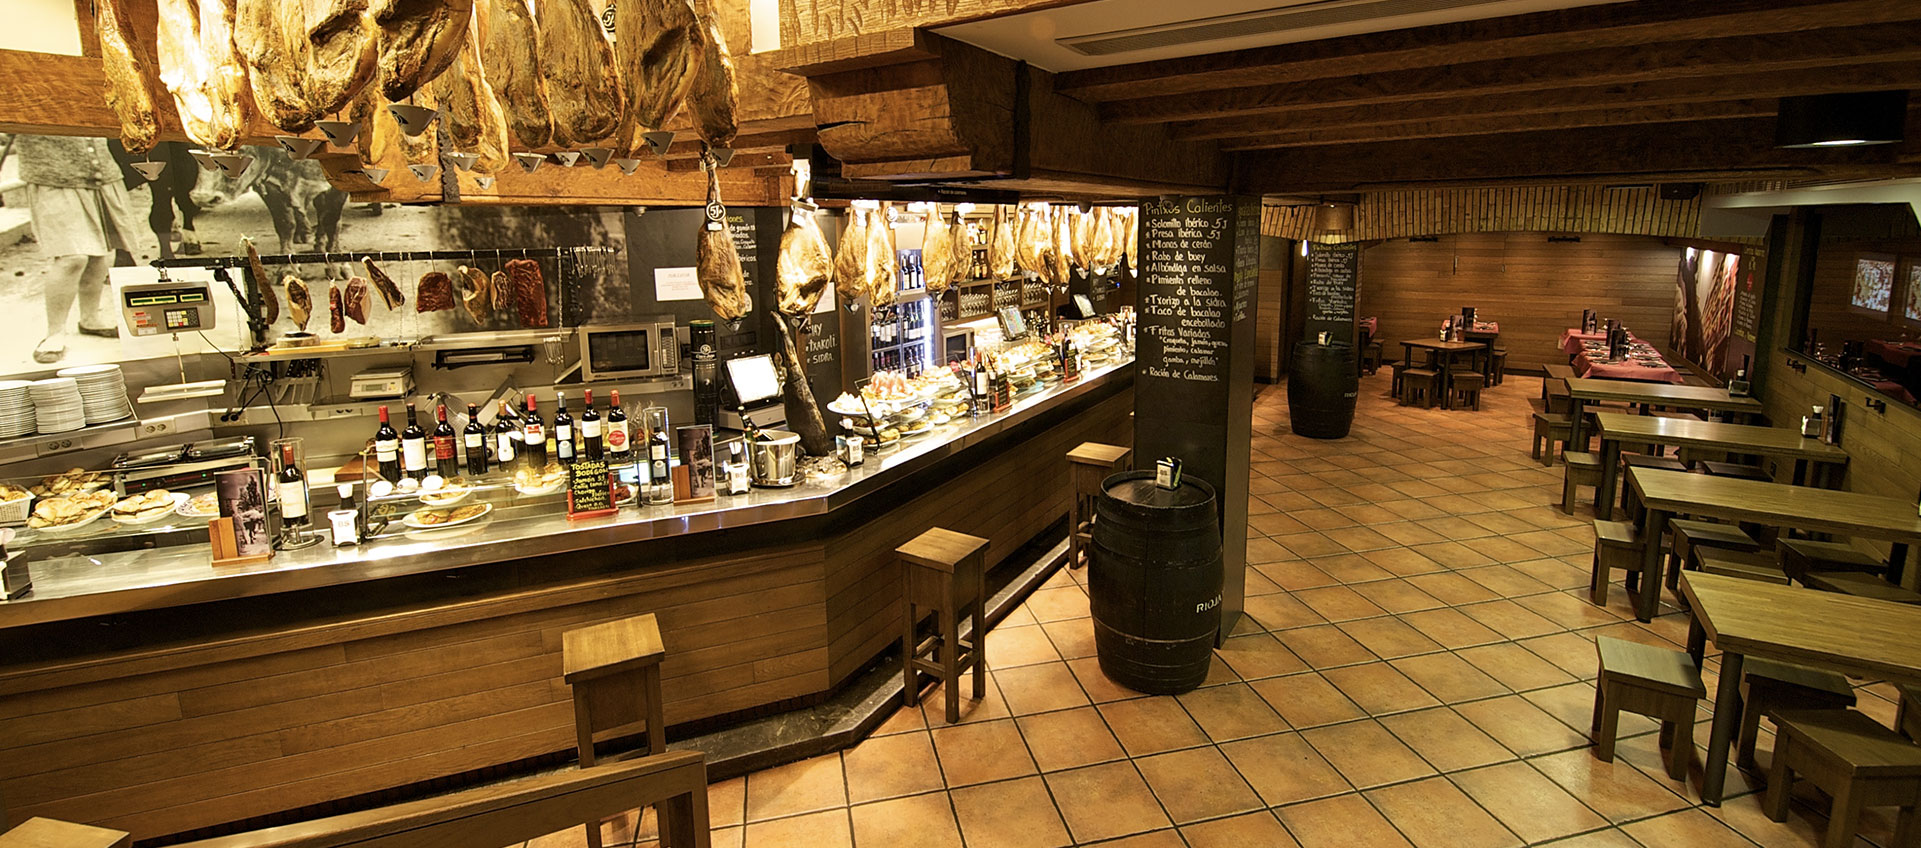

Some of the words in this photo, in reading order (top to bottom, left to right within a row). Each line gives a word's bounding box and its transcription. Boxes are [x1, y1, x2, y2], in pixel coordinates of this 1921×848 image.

[1143, 201, 1181, 215] Pintxos
[1187, 198, 1232, 214] Calientes
[1152, 217, 1182, 228] Solomillo
[1152, 228, 1174, 238] Presa
[1152, 240, 1178, 248] Manos
[1180, 239, 1189, 248] de
[1192, 240, 1212, 248] cerdo
[1152, 250, 1171, 261] Rabo
[1174, 250, 1184, 262] de
[1188, 250, 1206, 264] buey
[1151, 262, 1188, 276] Albóndiga
[1204, 264, 1226, 272] salsa
[1152, 274, 1184, 284] Pimiento
[1188, 274, 1212, 285] relleno
[1176, 286, 1186, 296] de
[1150, 294, 1180, 308] Txorizo
[1193, 296, 1202, 306] la
[1206, 298, 1226, 308] sidra
[1150, 305, 1172, 316] Taco
[1176, 306, 1186, 316] de
[1190, 306, 1221, 318] bacalao
[1181, 318, 1226, 328] encebollado
[1178, 328, 1211, 338] Variados
[1149, 366, 1170, 378] Ración
[1172, 370, 1180, 378] de
[571, 461, 606, 470] TOSTADAS
